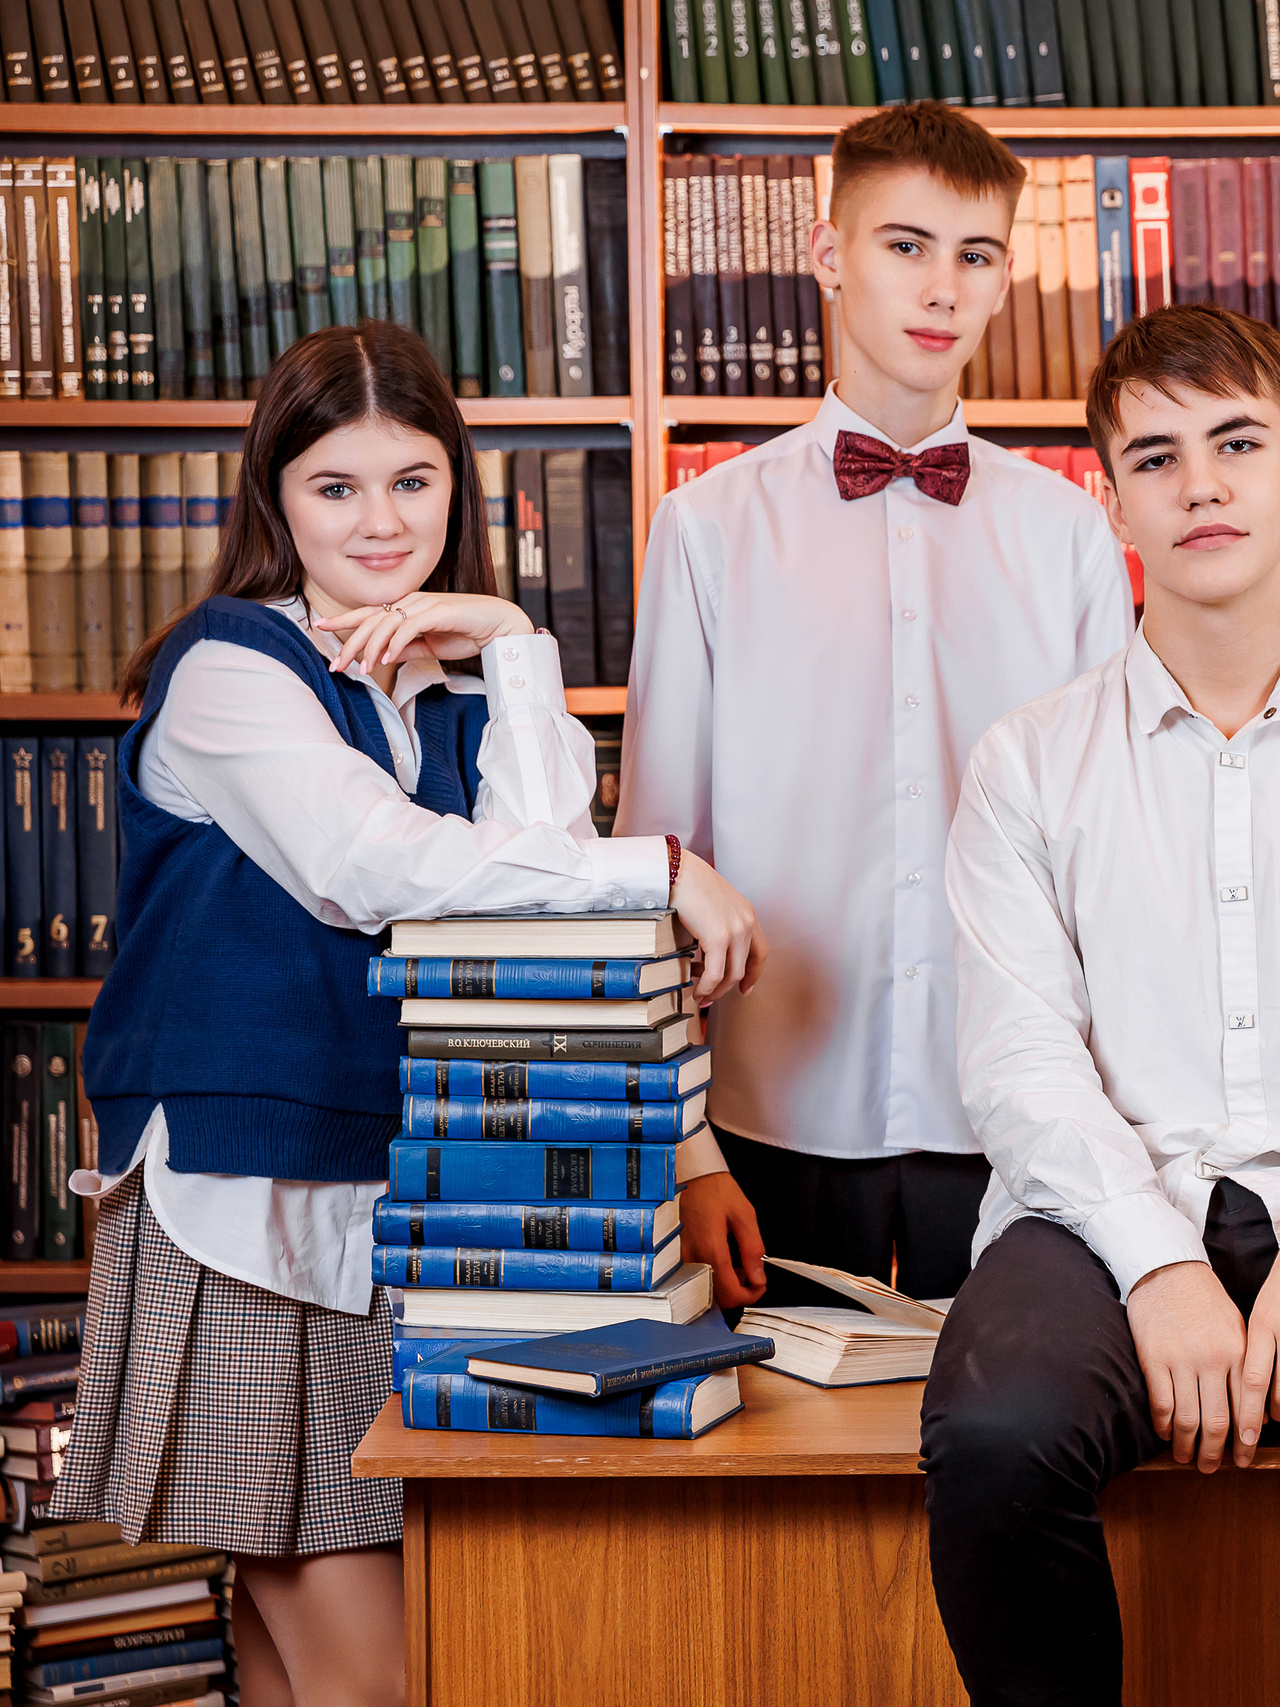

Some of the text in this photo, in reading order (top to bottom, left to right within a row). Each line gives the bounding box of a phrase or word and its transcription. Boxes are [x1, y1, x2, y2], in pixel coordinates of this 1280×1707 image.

[678, 38, 688, 58] 1
[705, 36, 718, 56] 2
[734, 35, 750, 58] 3
[763, 38, 776, 58] 4
[850, 36, 866, 56] 6
[674, 329, 682, 346] 1
[702, 328, 713, 346] 2
[726, 326, 738, 343] 3
[756, 326, 767, 342] 4
[782, 329, 793, 346] 5
[804, 327, 818, 344] 6
[50, 913, 68, 942] 6
[90, 915, 108, 942] 7
[17, 928, 34, 956] 5
[553, 1034, 568, 1052] IX
[582, 1038, 642, 1050] СОЧИНЕНИЯ
[628, 1077, 635, 1086] V
[52, 1556, 72, 1576] 2
